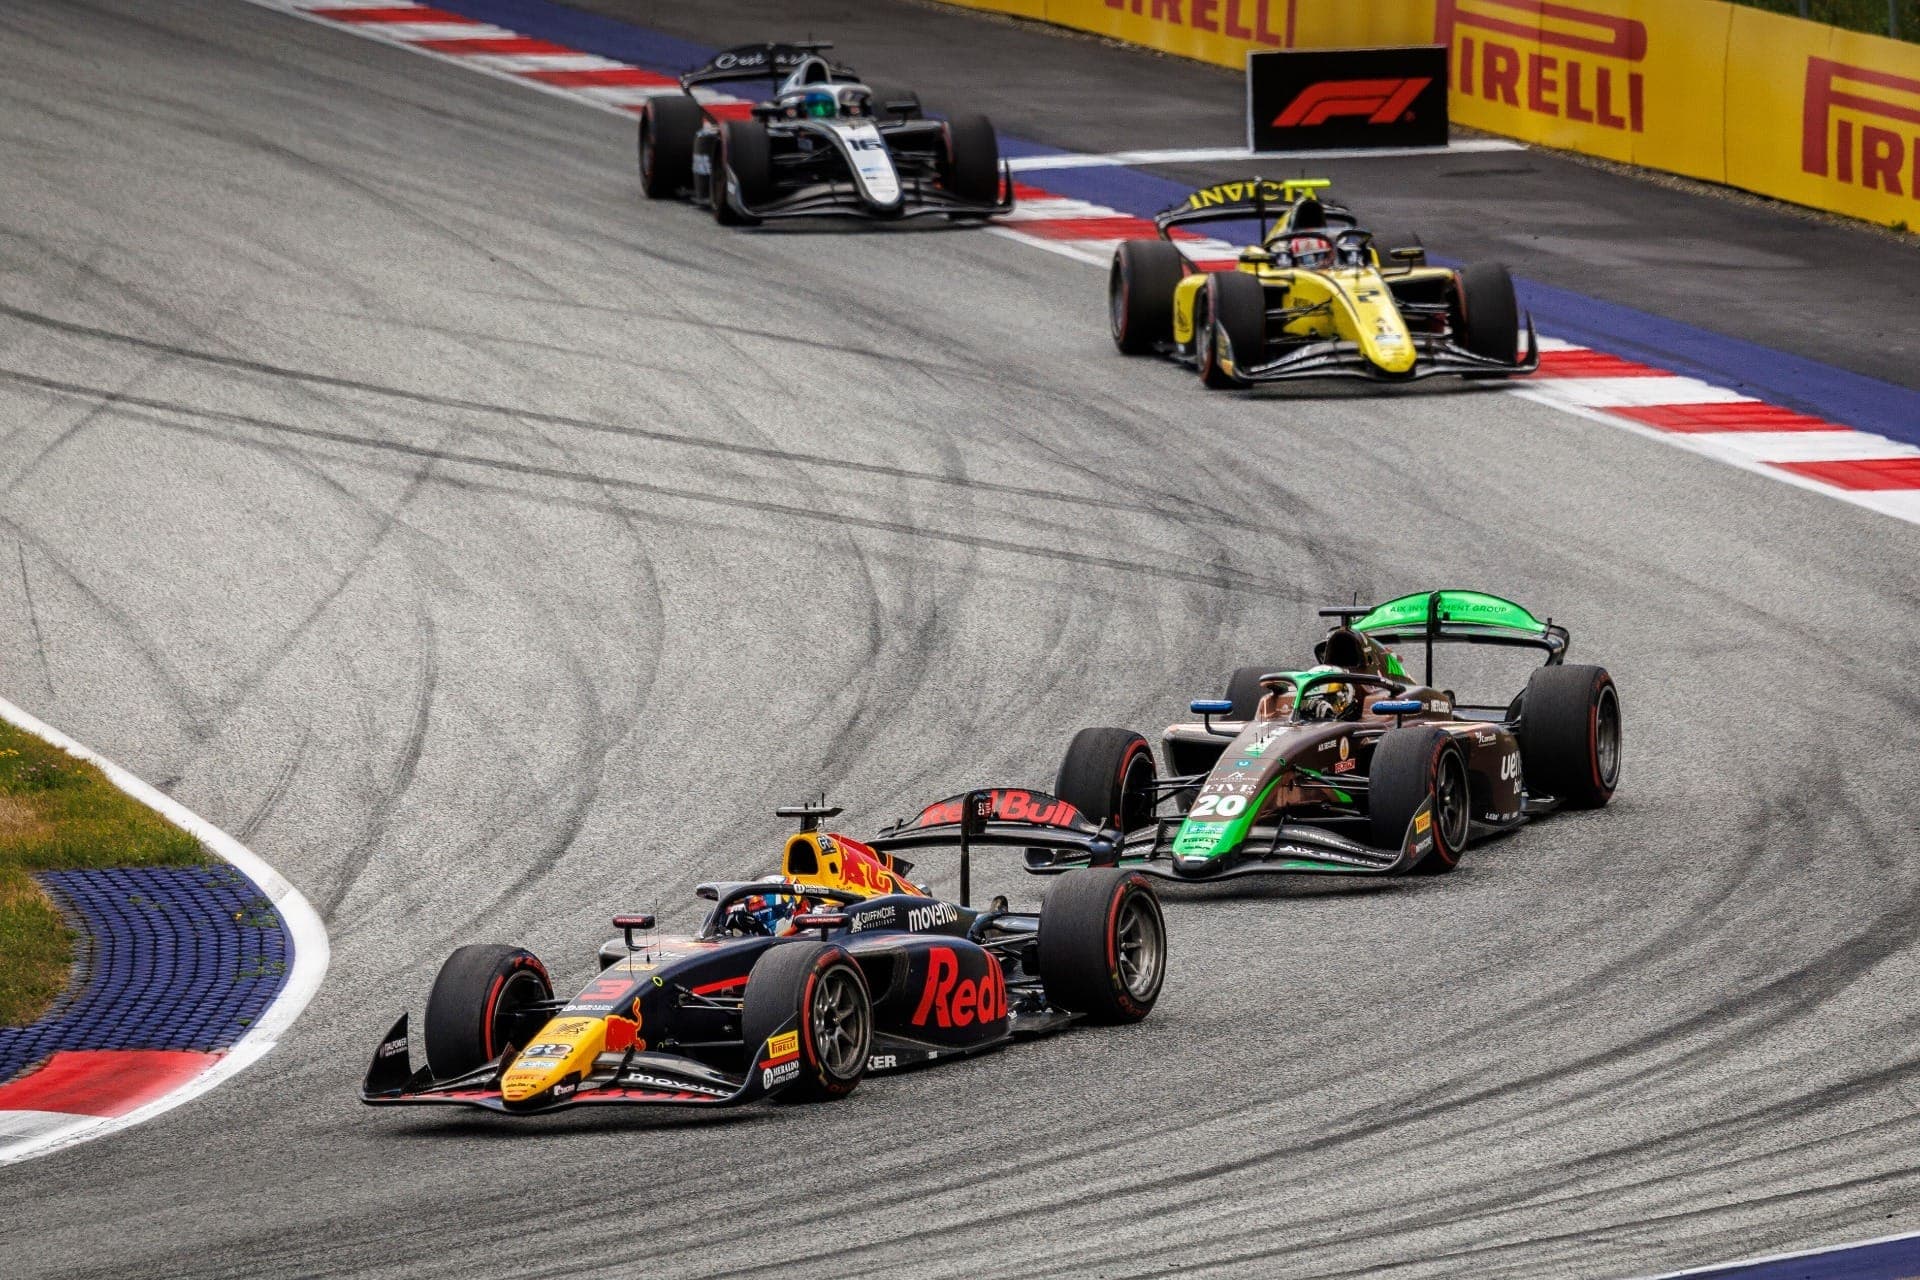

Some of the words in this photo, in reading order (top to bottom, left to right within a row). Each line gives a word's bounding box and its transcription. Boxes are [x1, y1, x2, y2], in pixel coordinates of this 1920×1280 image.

[1434, 0, 1648, 133] PIRELLI
[1271, 77, 1433, 127] F1
[1802, 55, 1920, 200] PIR
[1189, 181, 1317, 209] INVICT
[1472, 604, 1507, 613] GROUP
[1001, 791, 1076, 827] Bull
[1190, 794, 1248, 817] 20
[908, 902, 958, 933] movento
